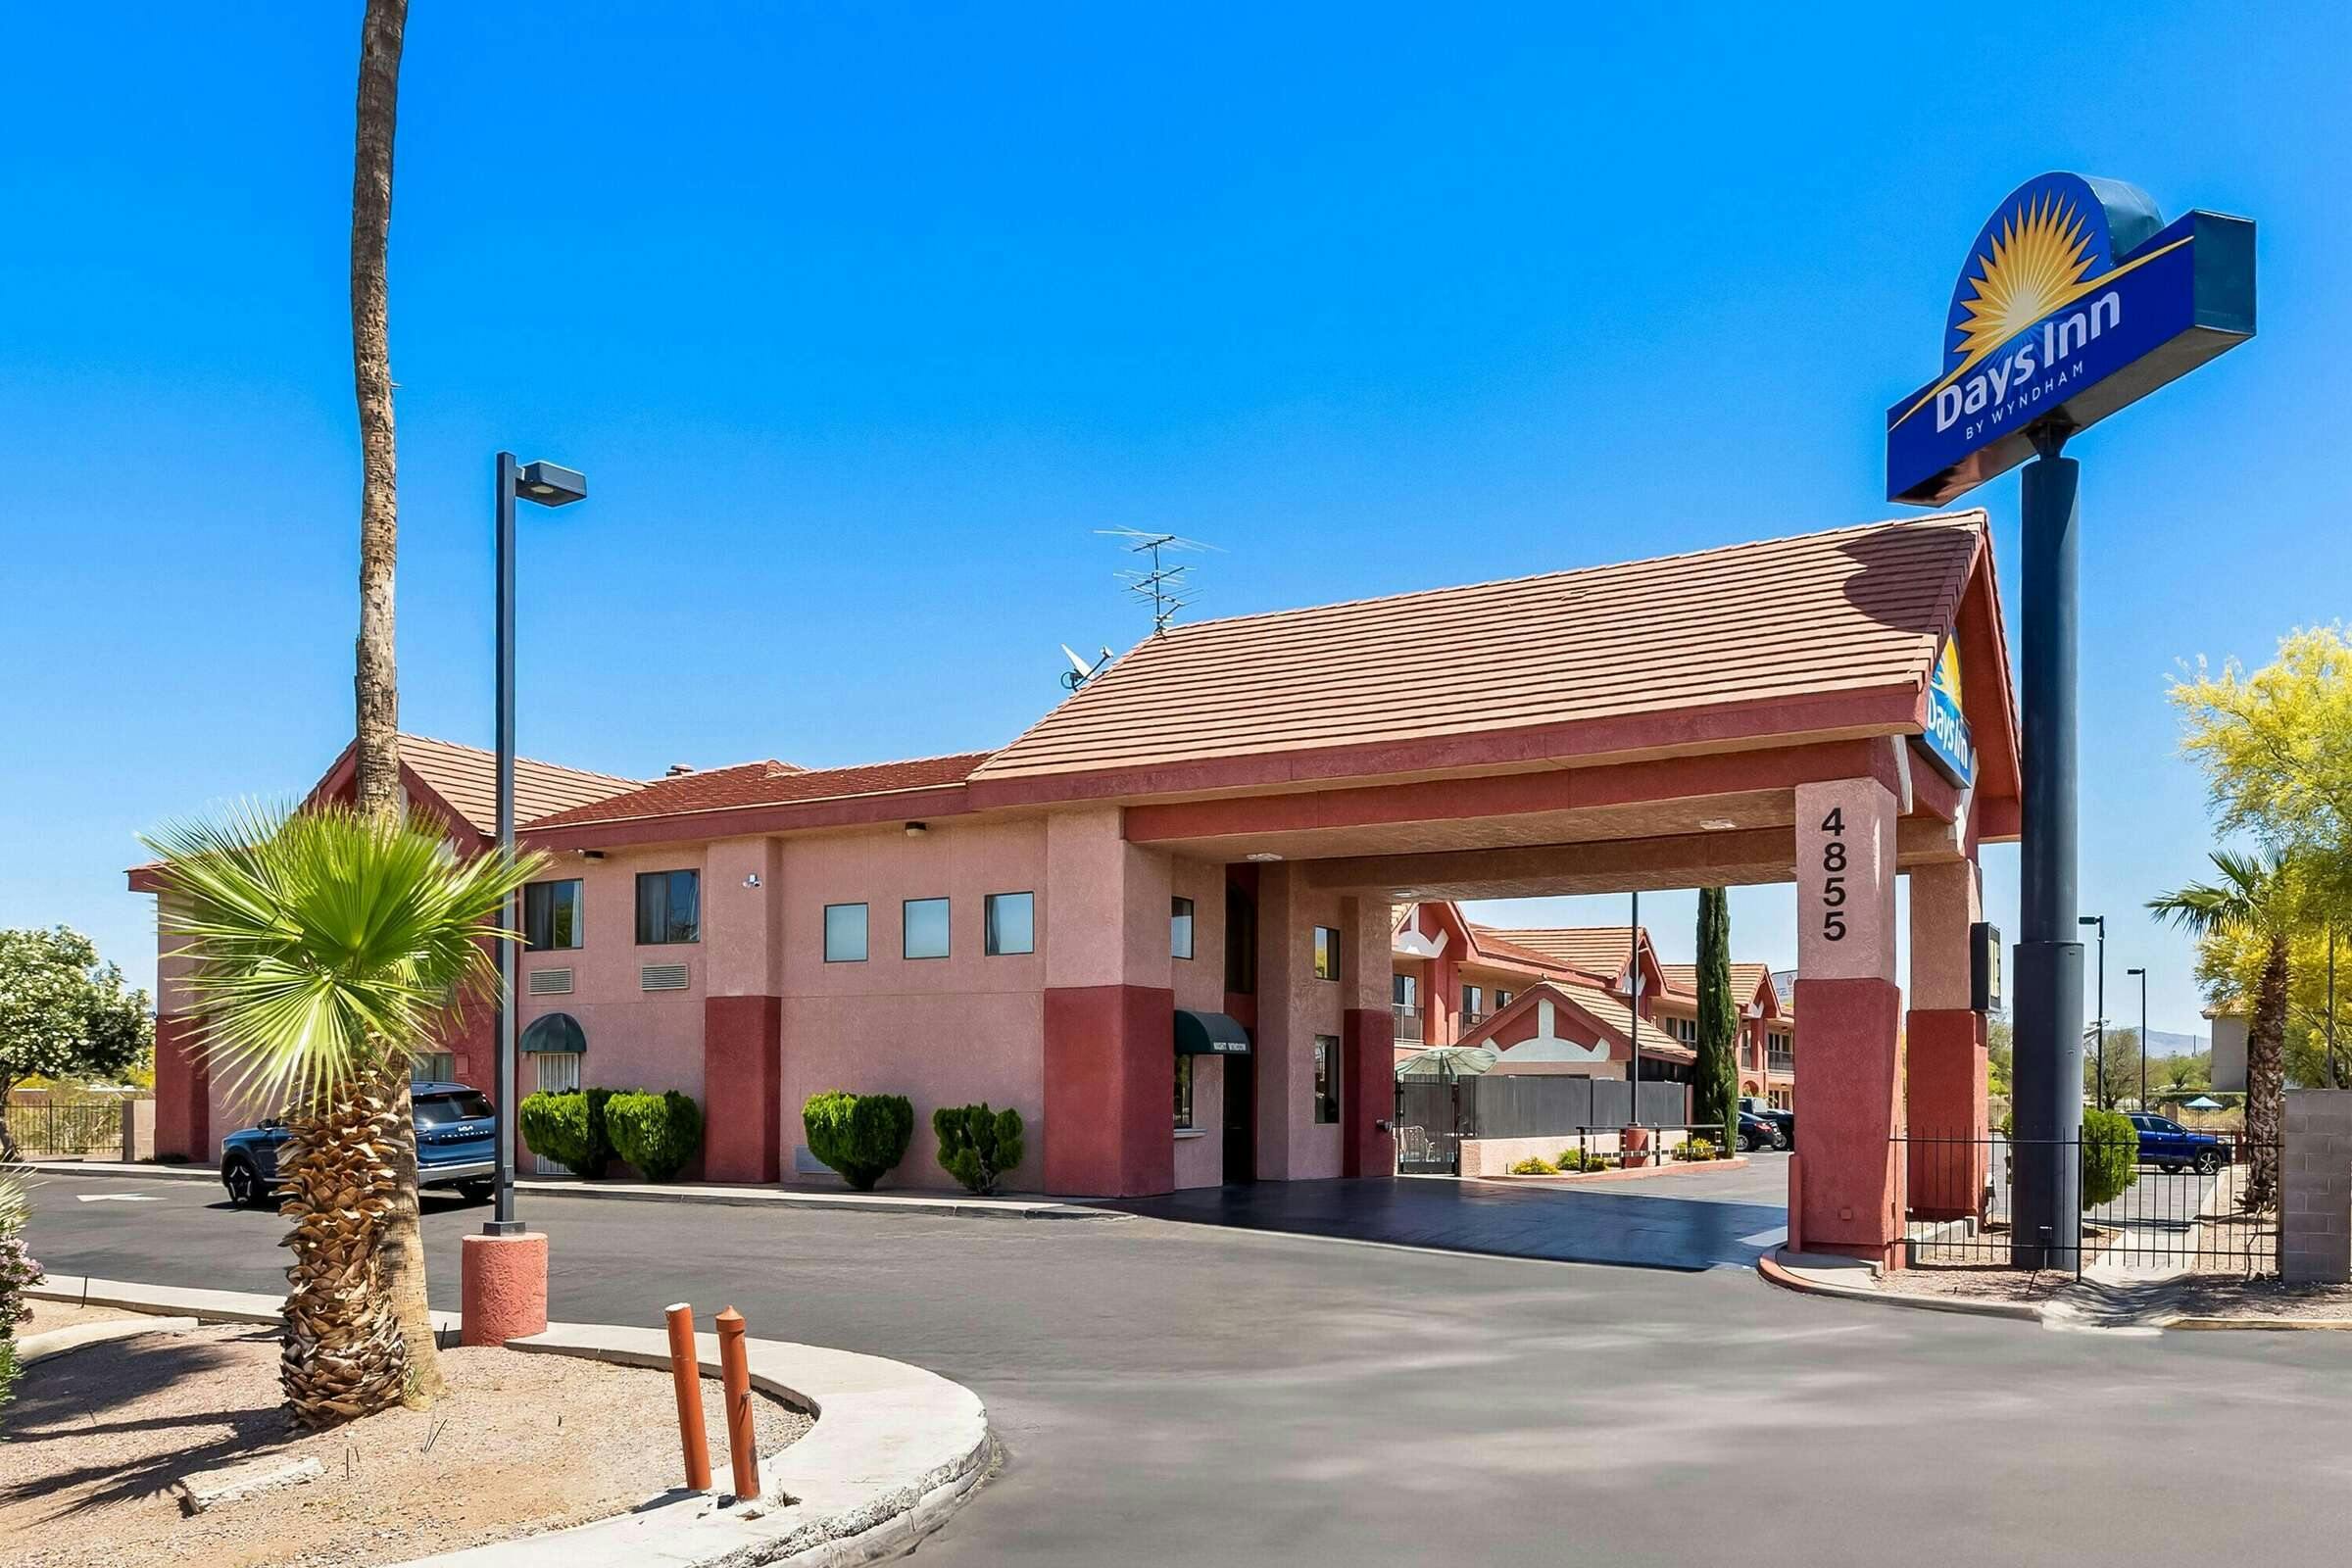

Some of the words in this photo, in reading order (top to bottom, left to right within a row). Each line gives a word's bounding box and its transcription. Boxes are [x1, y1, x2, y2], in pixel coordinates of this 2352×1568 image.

[1936, 343, 2035, 434] Days
[2043, 291, 2121, 369] Inn
[1965, 419, 1984, 441] BY
[1991, 360, 2084, 424] WYNDHAM
[1928, 689, 1955, 752] Days
[1821, 807, 1847, 942] 4855
